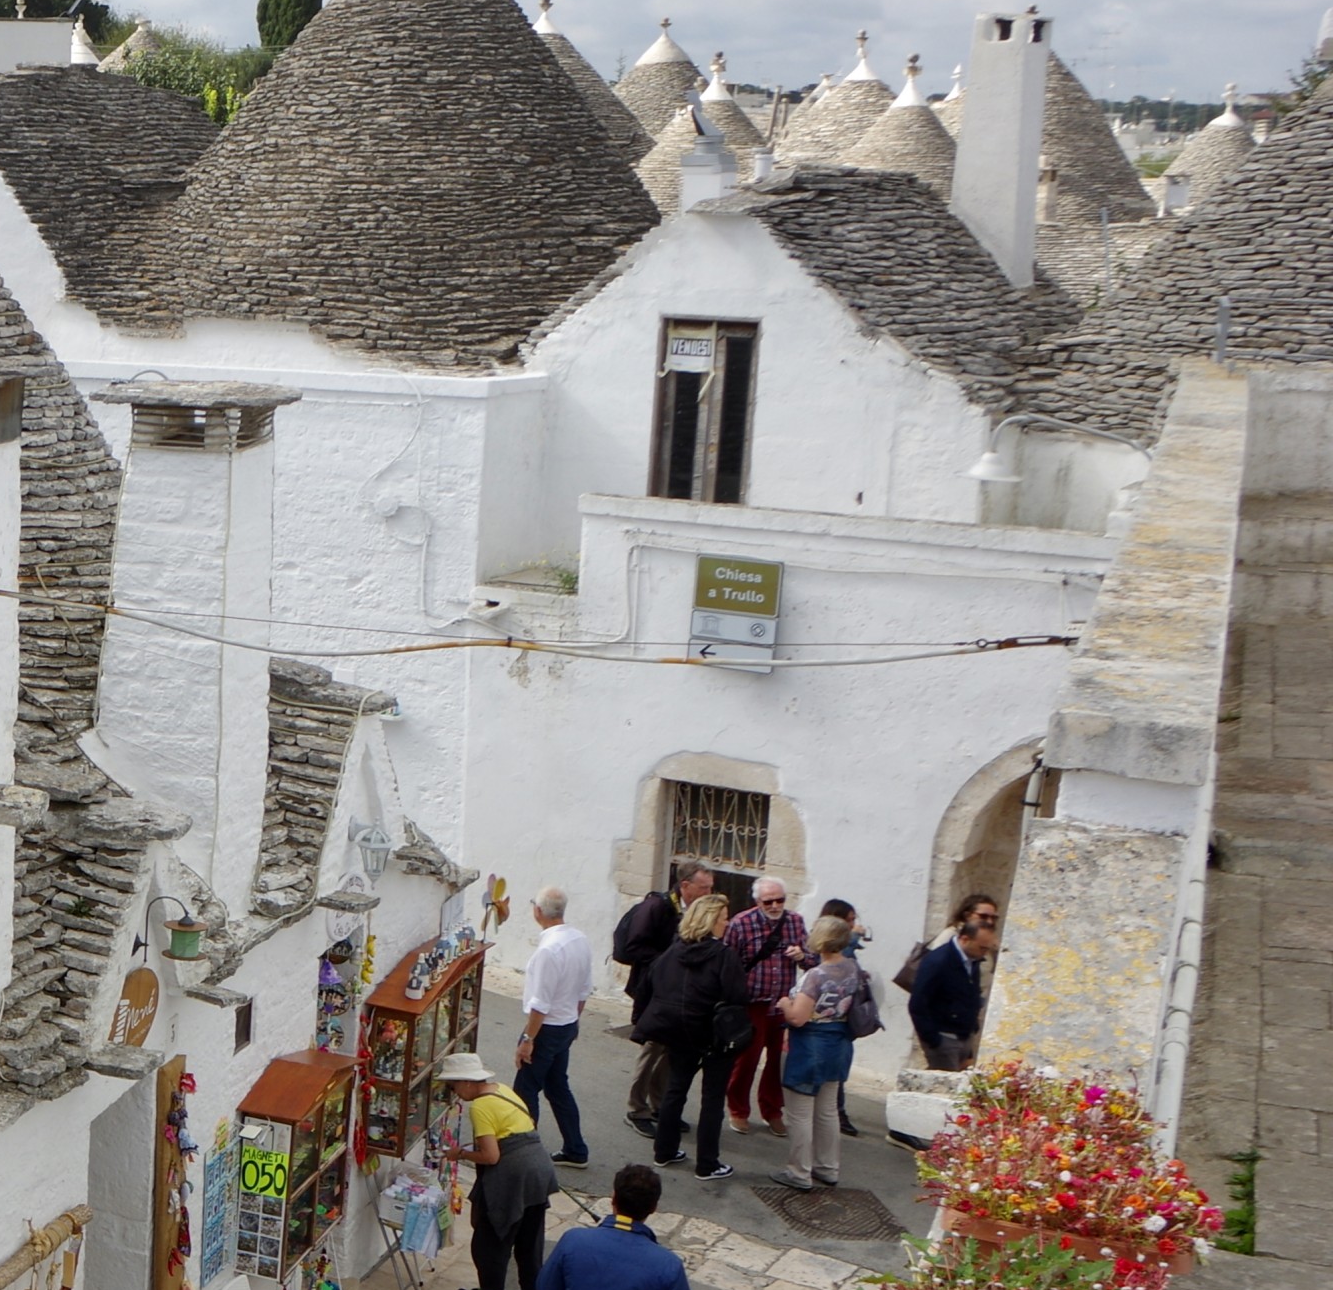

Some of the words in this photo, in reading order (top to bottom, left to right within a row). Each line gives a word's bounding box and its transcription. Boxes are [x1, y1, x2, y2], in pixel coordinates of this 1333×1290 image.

[672, 339, 711, 356] VENDESI
[715, 567, 762, 583] Chiesa
[708, 588, 717, 598] a
[722, 587, 765, 603] Trullo
[243, 1147, 285, 1163] MAGNETI
[242, 1160, 287, 1196] 0,50
